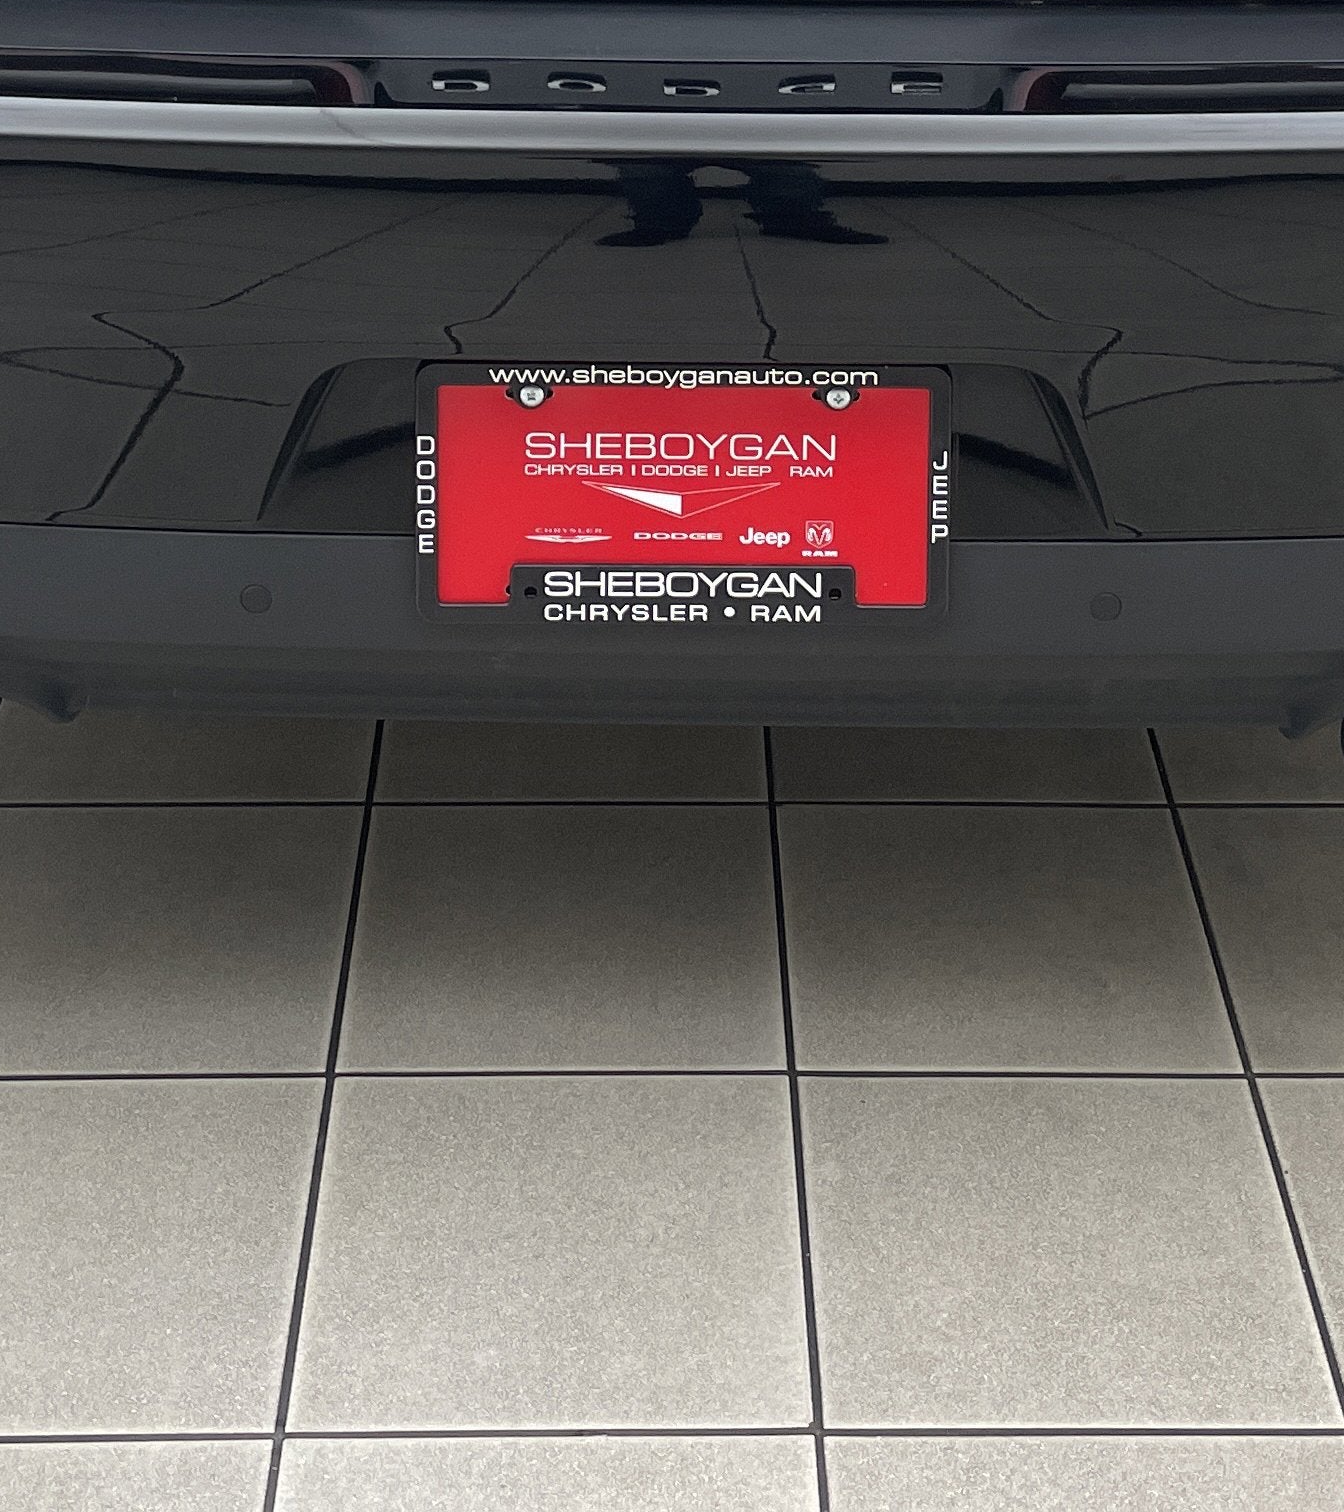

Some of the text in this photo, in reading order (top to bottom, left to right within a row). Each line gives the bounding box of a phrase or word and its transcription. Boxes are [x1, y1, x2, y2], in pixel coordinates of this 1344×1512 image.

[487, 365, 879, 390] www.sheboyganauto.com
[524, 432, 837, 461] SHEBOYGAN
[523, 463, 835, 479] CHRYSLER DODGE JEEP RAM
[415, 434, 437, 555] DODGE
[931, 449, 950, 545] JEEP
[632, 531, 724, 542] DODGE
[738, 526, 792, 549] Jeep
[800, 549, 840, 559] RAM
[543, 569, 823, 599] SHEBOYGAN
[542, 602, 823, 624] CHRYSLER RAM
